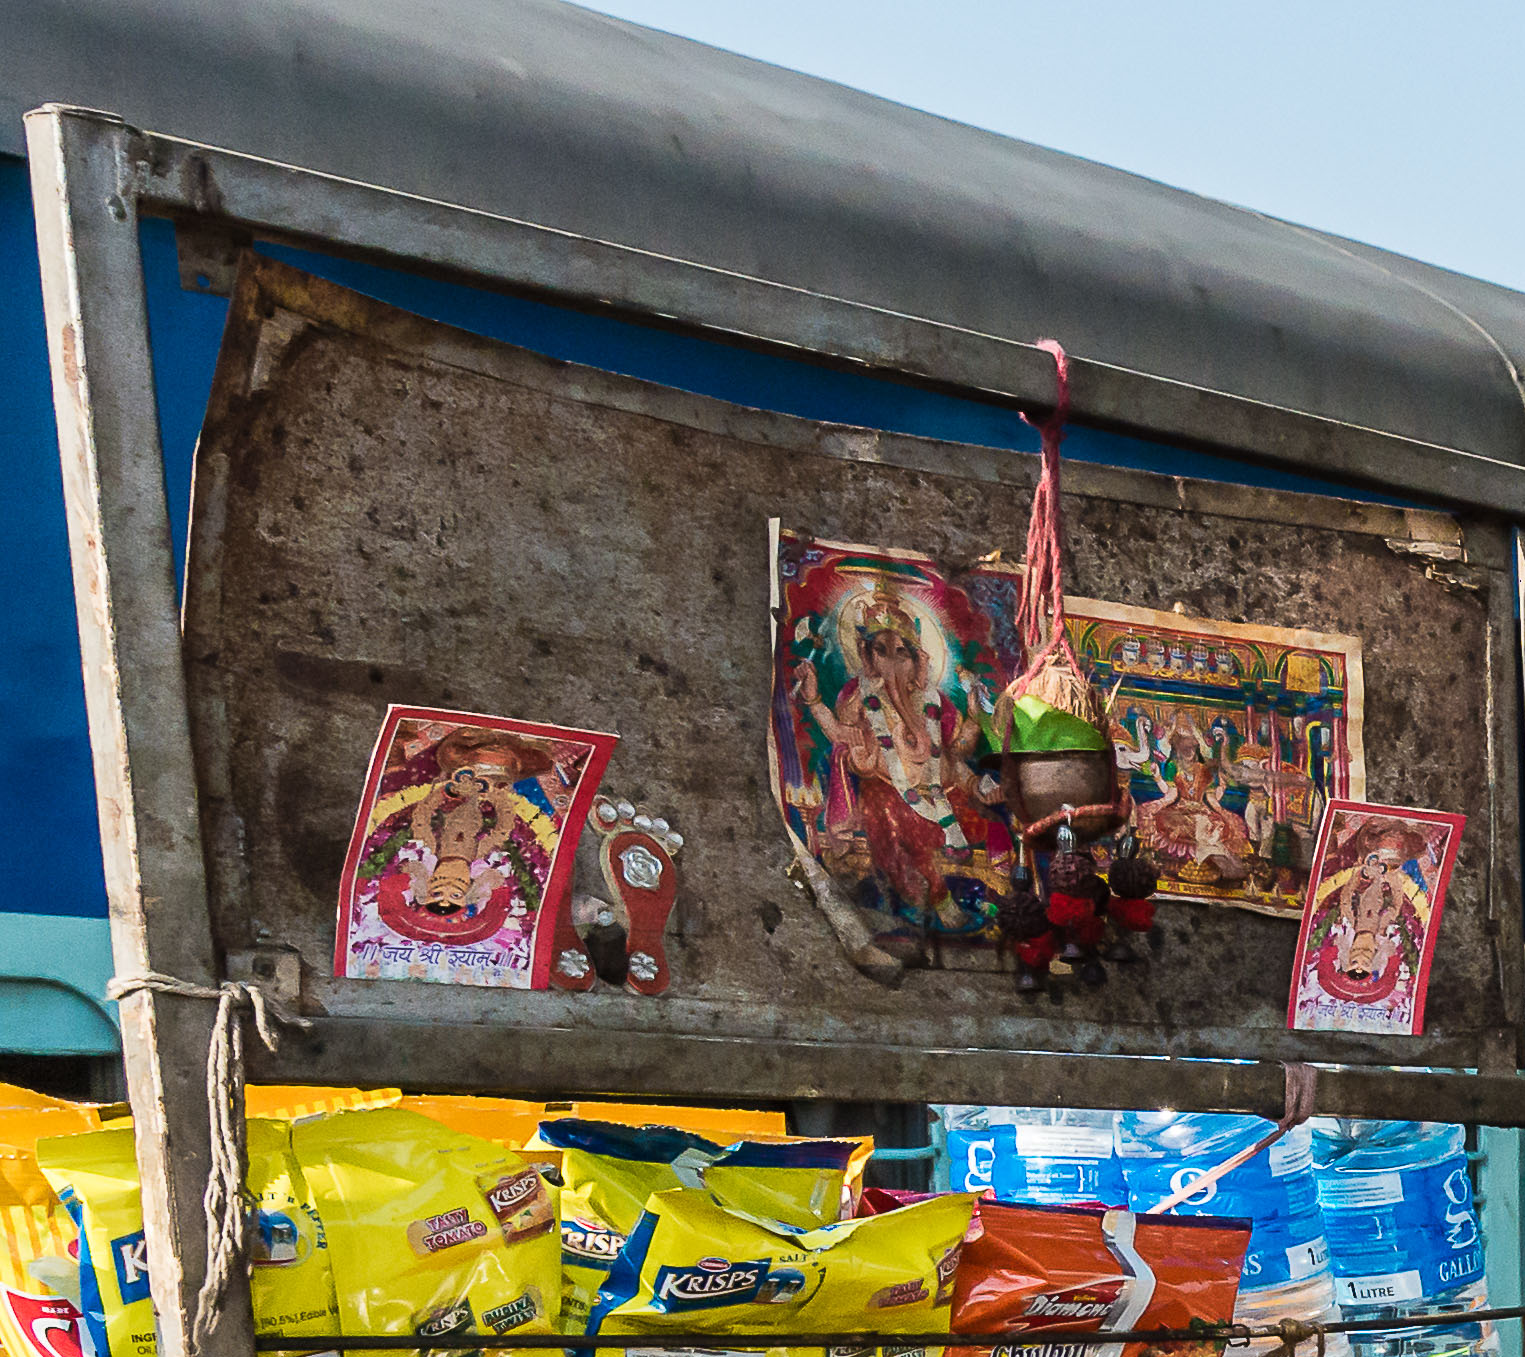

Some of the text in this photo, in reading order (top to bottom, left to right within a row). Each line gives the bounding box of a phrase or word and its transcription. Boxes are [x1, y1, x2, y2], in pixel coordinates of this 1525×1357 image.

[382, 945, 415, 963] जय
[419, 943, 444, 965] श्री
[489, 1175, 538, 1213] KRISPS
[425, 1208, 469, 1234] TASTY
[423, 1221, 487, 1251] TOMATO
[661, 1266, 760, 1301] KRISPS
[1347, 1282, 1395, 1299] 1 LITRE
